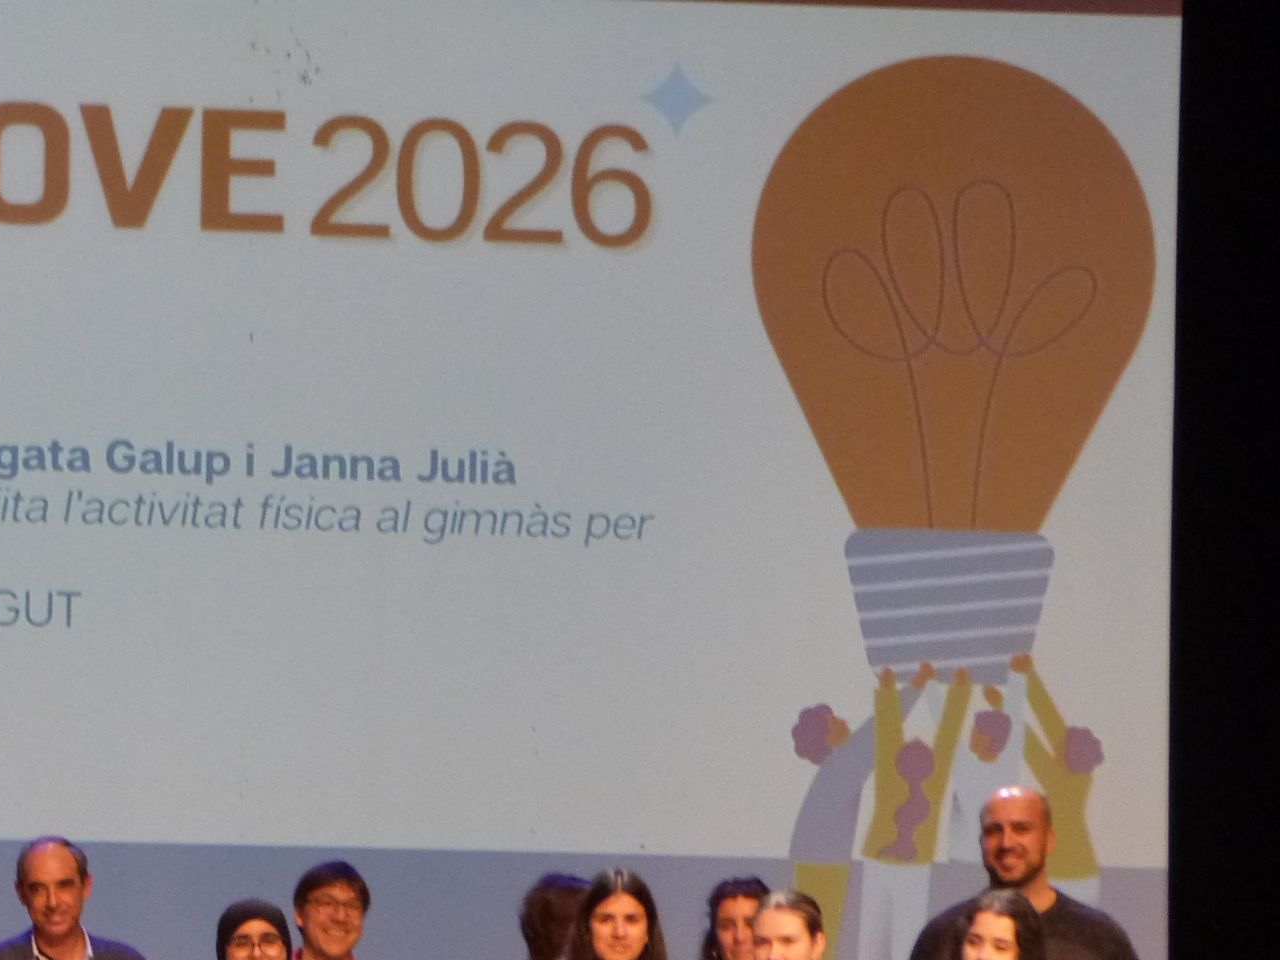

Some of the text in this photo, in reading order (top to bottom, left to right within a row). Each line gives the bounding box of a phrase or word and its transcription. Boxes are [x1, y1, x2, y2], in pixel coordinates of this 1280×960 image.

[310, 115, 653, 248] 2026
[106, 439, 231, 485] Galup
[246, 443, 254, 477] i
[271, 445, 401, 482] Janna
[417, 449, 516, 485] Julià
[260, 494, 361, 532] física
[376, 500, 411, 533] al
[424, 503, 571, 545] gimnàs
[584, 513, 654, 547] per
